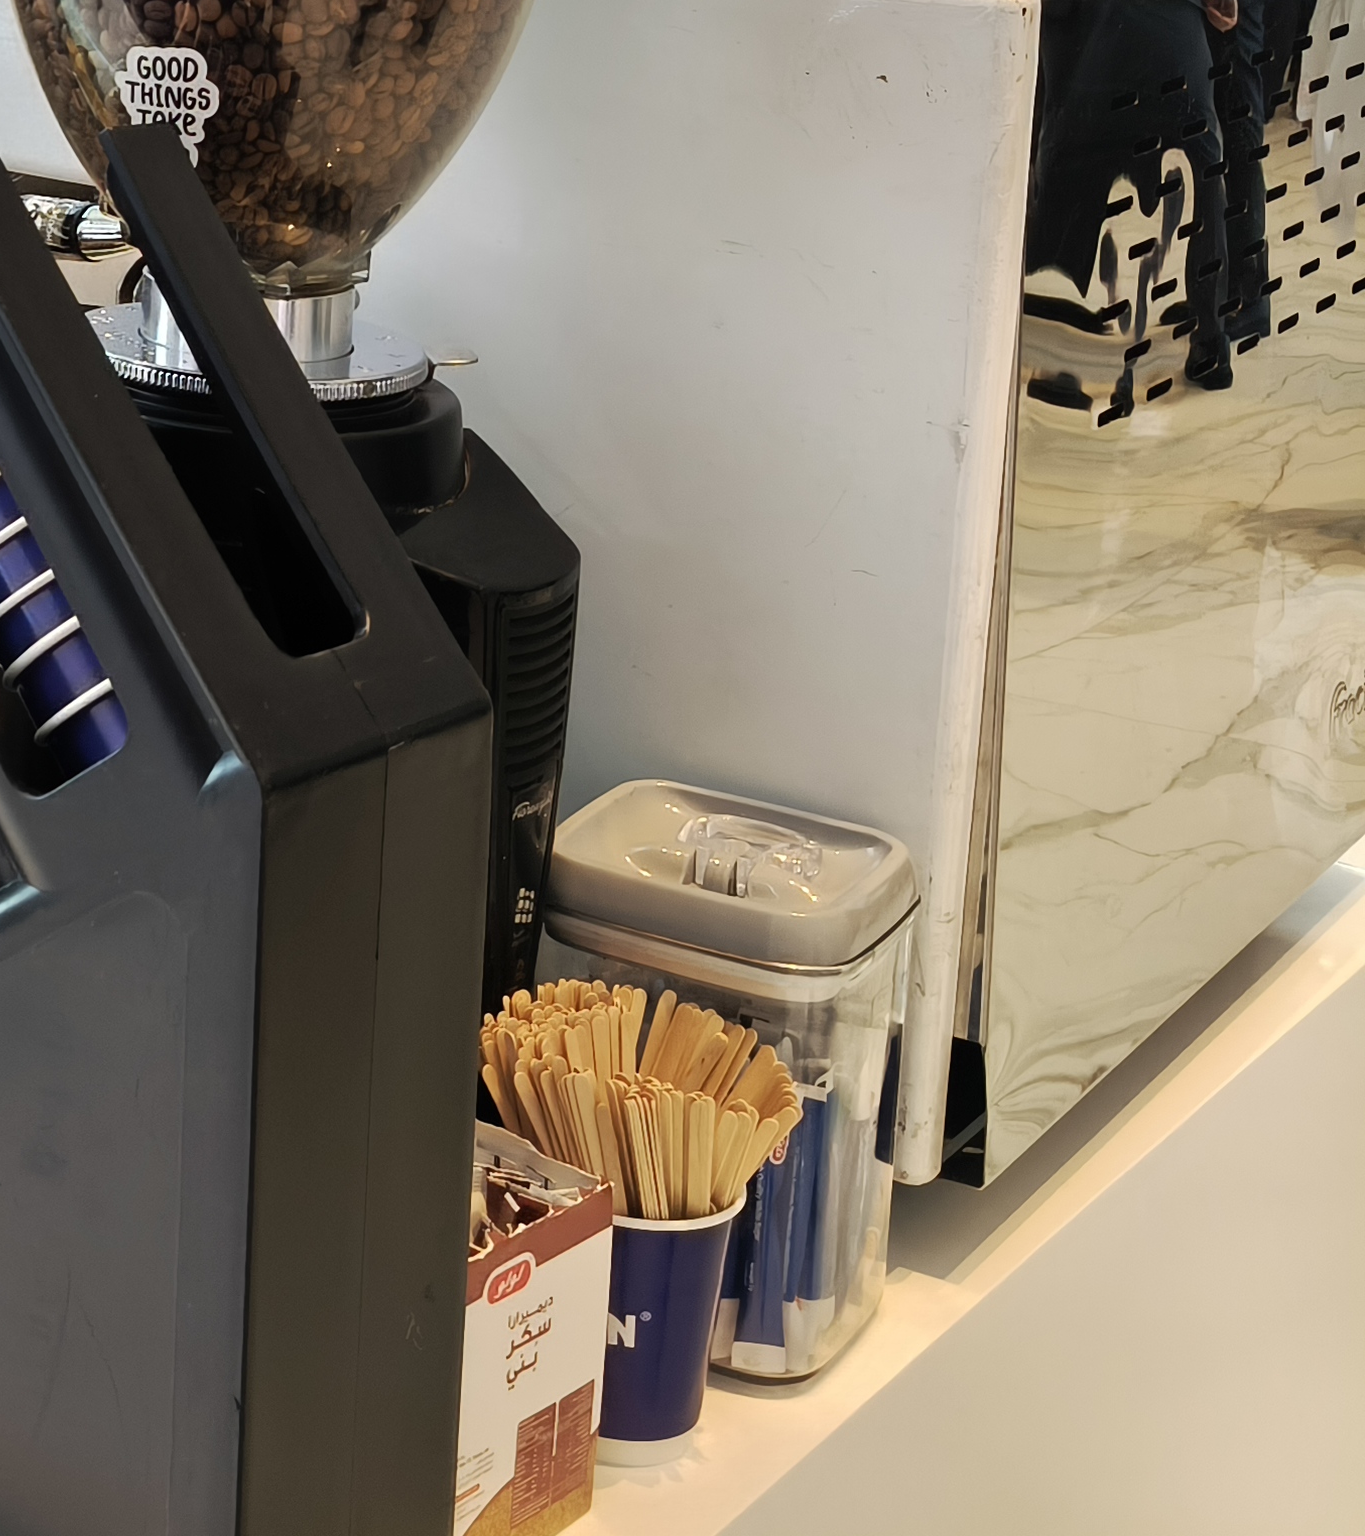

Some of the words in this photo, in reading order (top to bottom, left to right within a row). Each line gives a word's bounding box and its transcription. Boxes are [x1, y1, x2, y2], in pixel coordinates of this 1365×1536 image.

[137, 55, 199, 83] GOOD
[125, 80, 211, 111] THINGS
[506, 1317, 552, 1360] سكر
